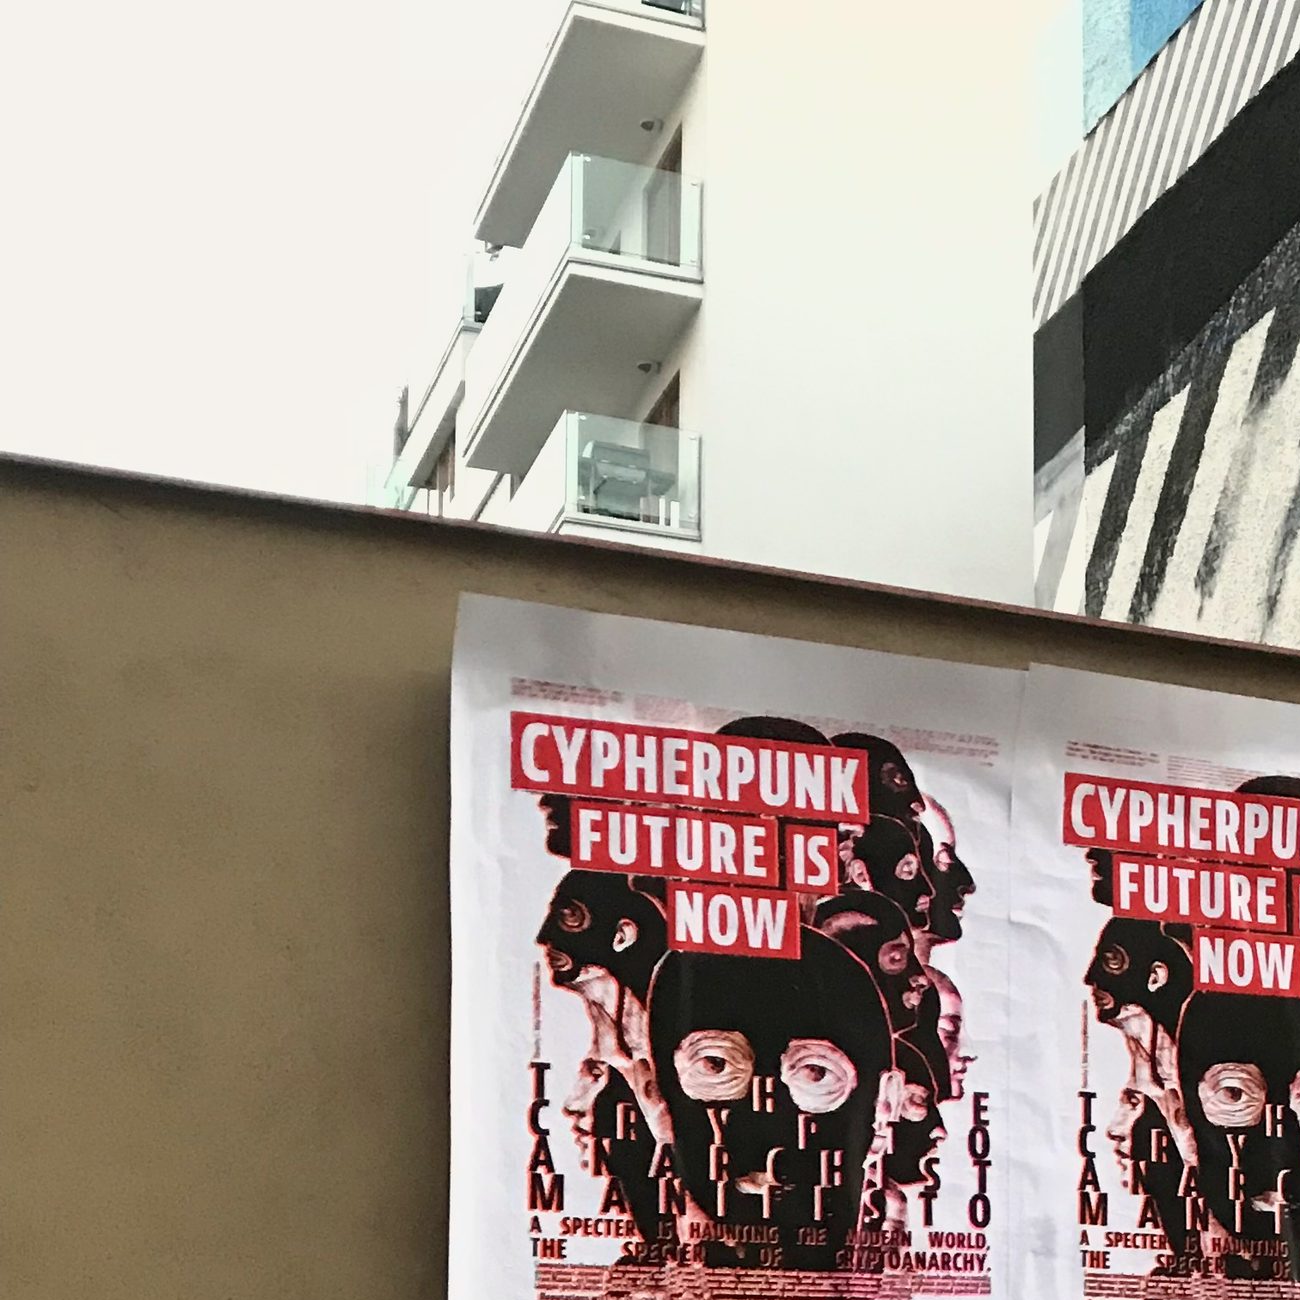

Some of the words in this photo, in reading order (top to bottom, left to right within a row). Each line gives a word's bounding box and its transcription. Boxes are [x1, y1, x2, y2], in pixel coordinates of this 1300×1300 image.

[519, 722, 858, 814] CYPHERPUNK
[579, 808, 766, 877] FUTURE
[793, 833, 829, 886] IS
[676, 889, 787, 949] NOW
[1119, 861, 1277, 924] FUTURE
[1200, 935, 1294, 989] NOW
[528, 1215, 542, 1233] A
[559, 1216, 637, 1237] SPECTER
[529, 1237, 567, 1259] THE
[1079, 1229, 1090, 1246] A
[1104, 1231, 1168, 1250] SPECTER
[1079, 1249, 1110, 1269] THE
